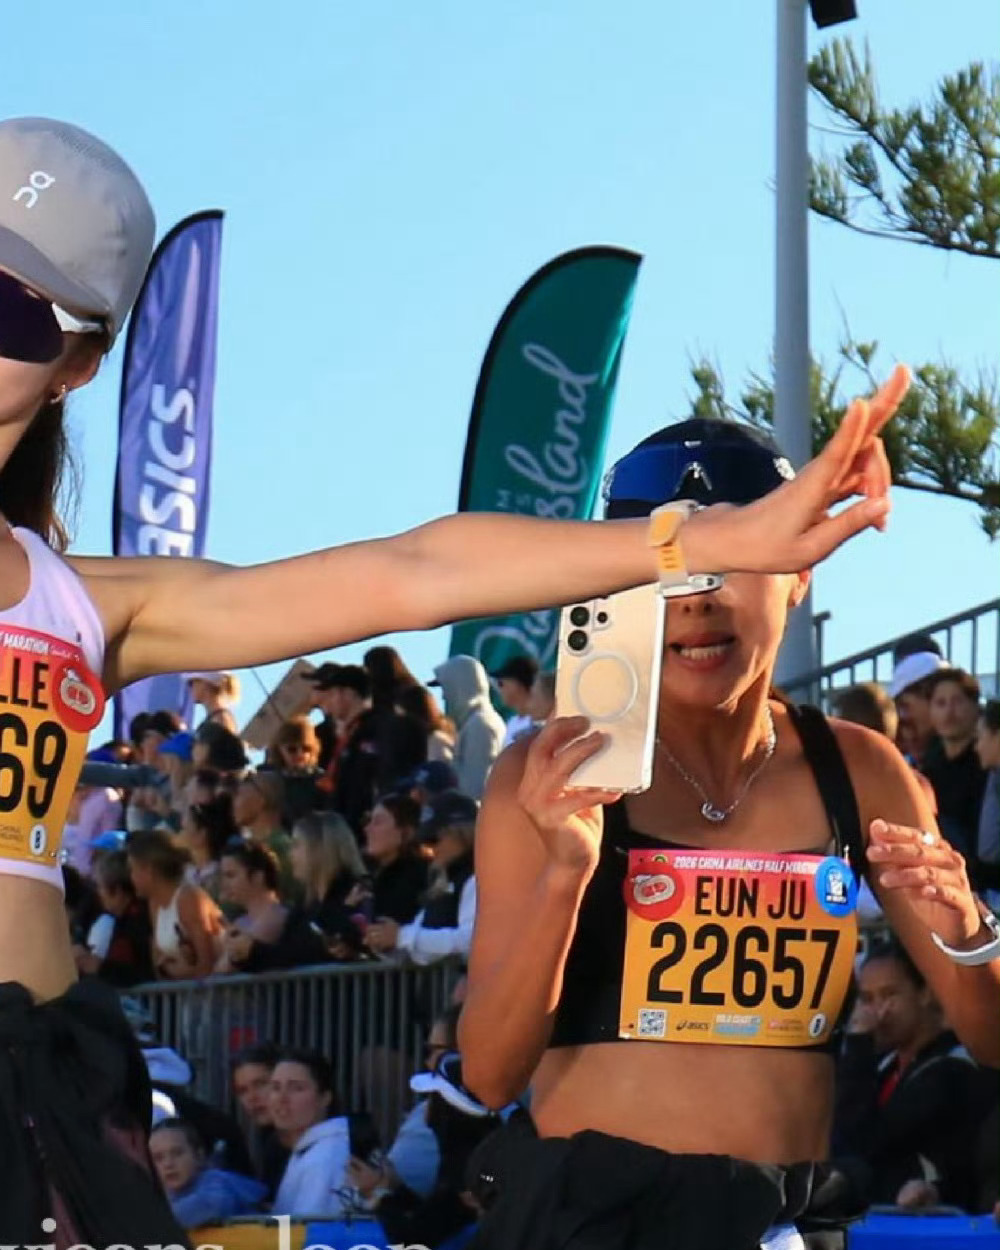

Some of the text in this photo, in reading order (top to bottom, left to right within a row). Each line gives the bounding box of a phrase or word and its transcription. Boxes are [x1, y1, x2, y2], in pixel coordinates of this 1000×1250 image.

[695, 875, 807, 920] EUN JU
[647, 922, 841, 1010] 22657
